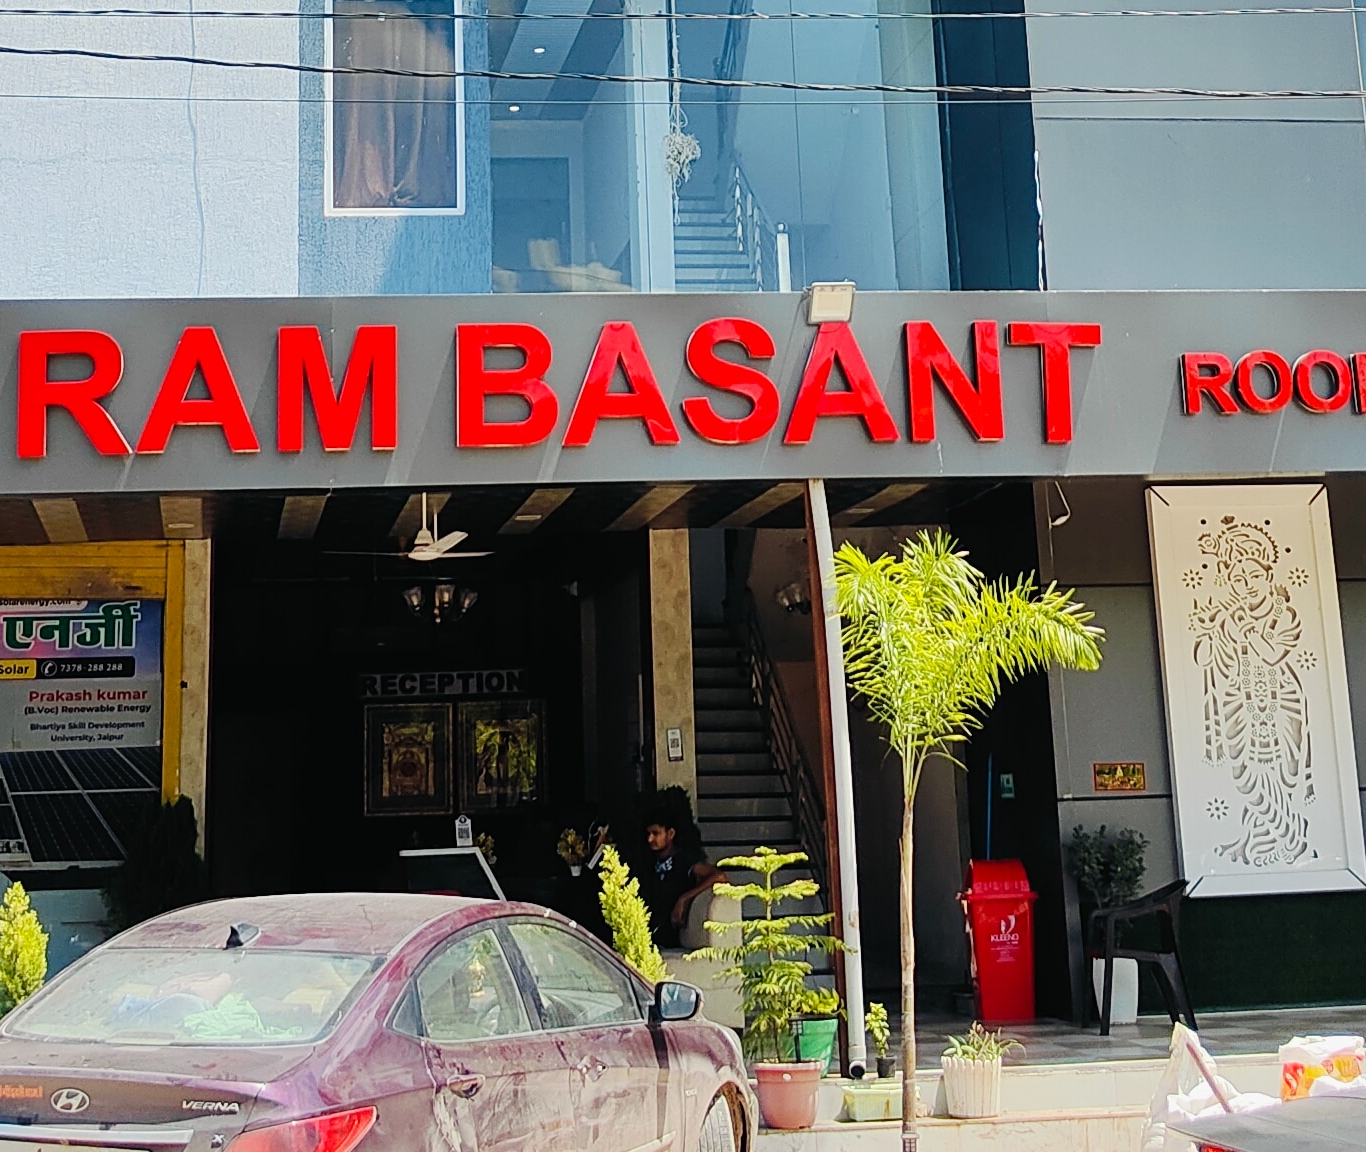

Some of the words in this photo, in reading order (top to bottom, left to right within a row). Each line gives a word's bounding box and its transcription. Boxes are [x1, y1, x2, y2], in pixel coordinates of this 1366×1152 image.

[16, 324, 399, 460] RAM
[455, 316, 1102, 448] BASANT
[0, 600, 141, 651] एनर्जी
[106, 663, 123, 672] 288
[362, 671, 523, 696] RECEPTION
[29, 689, 92, 702] Prakash
[97, 689, 148, 701] kumar
[24, 705, 59, 715] (B.Voc)
[61, 705, 115, 714] Renewable
[117, 704, 151, 713] Energy
[30, 722, 66, 732] Bhartiya
[88, 721, 145, 731] Development
[51, 734, 96, 742] University,
[97, 733, 124, 742] Jaipur
[182, 1100, 240, 1112] VERNA
